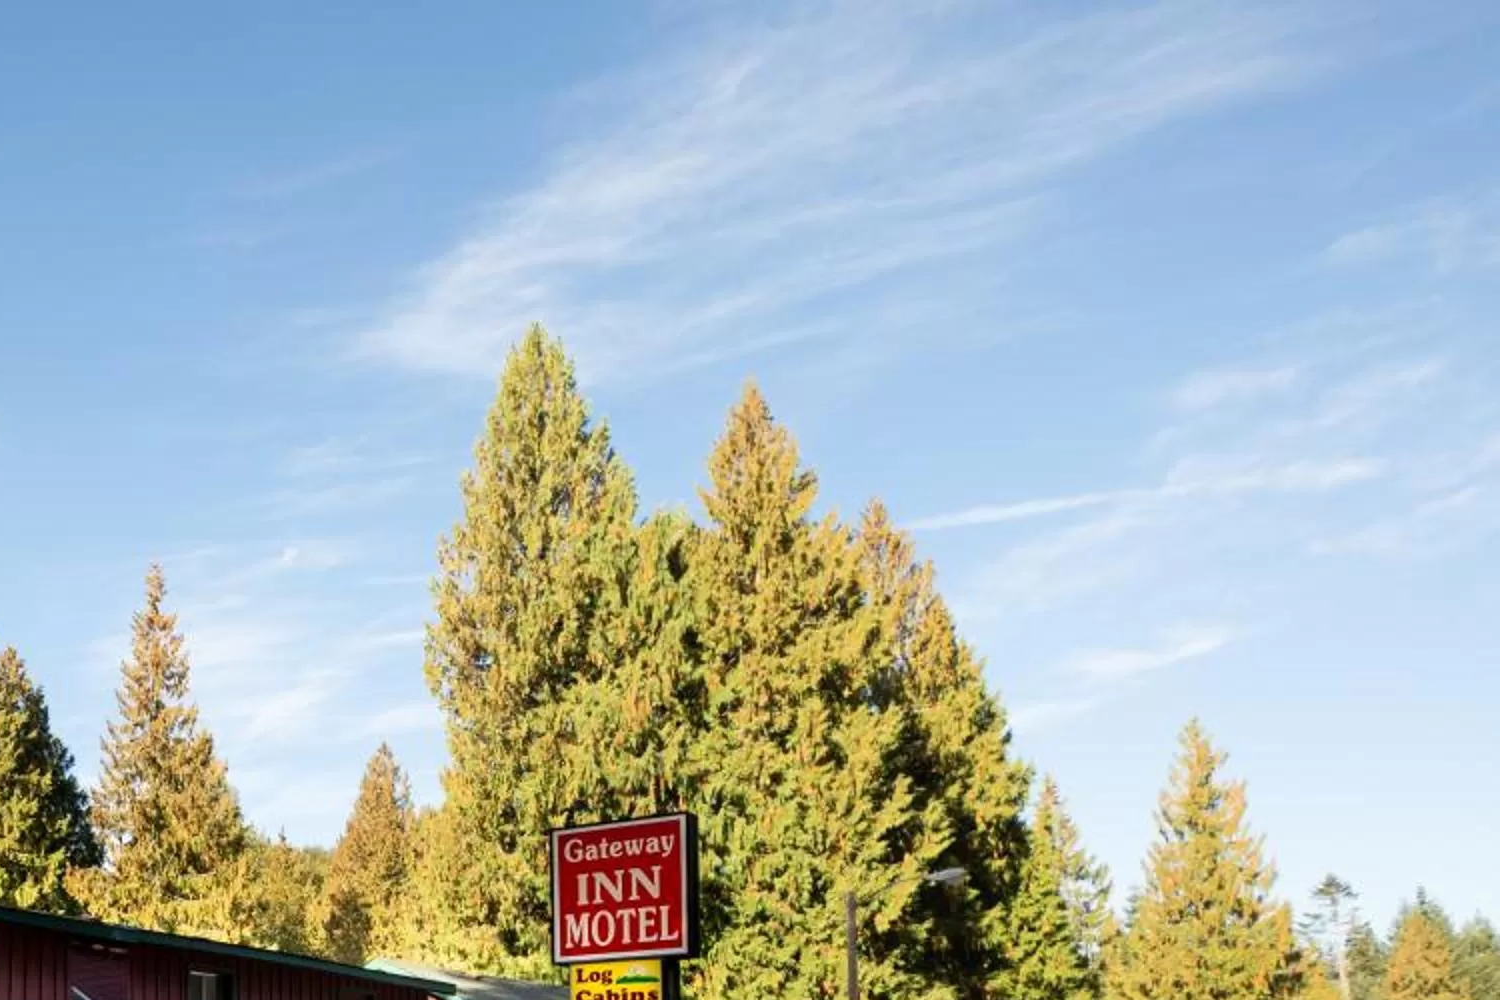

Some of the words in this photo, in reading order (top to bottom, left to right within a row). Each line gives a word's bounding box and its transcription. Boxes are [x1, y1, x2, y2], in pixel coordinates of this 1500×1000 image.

[563, 834, 675, 864] Gateway
[576, 865, 663, 906] INN
[564, 905, 679, 949] MOTEL
[576, 968, 613, 987] Log
